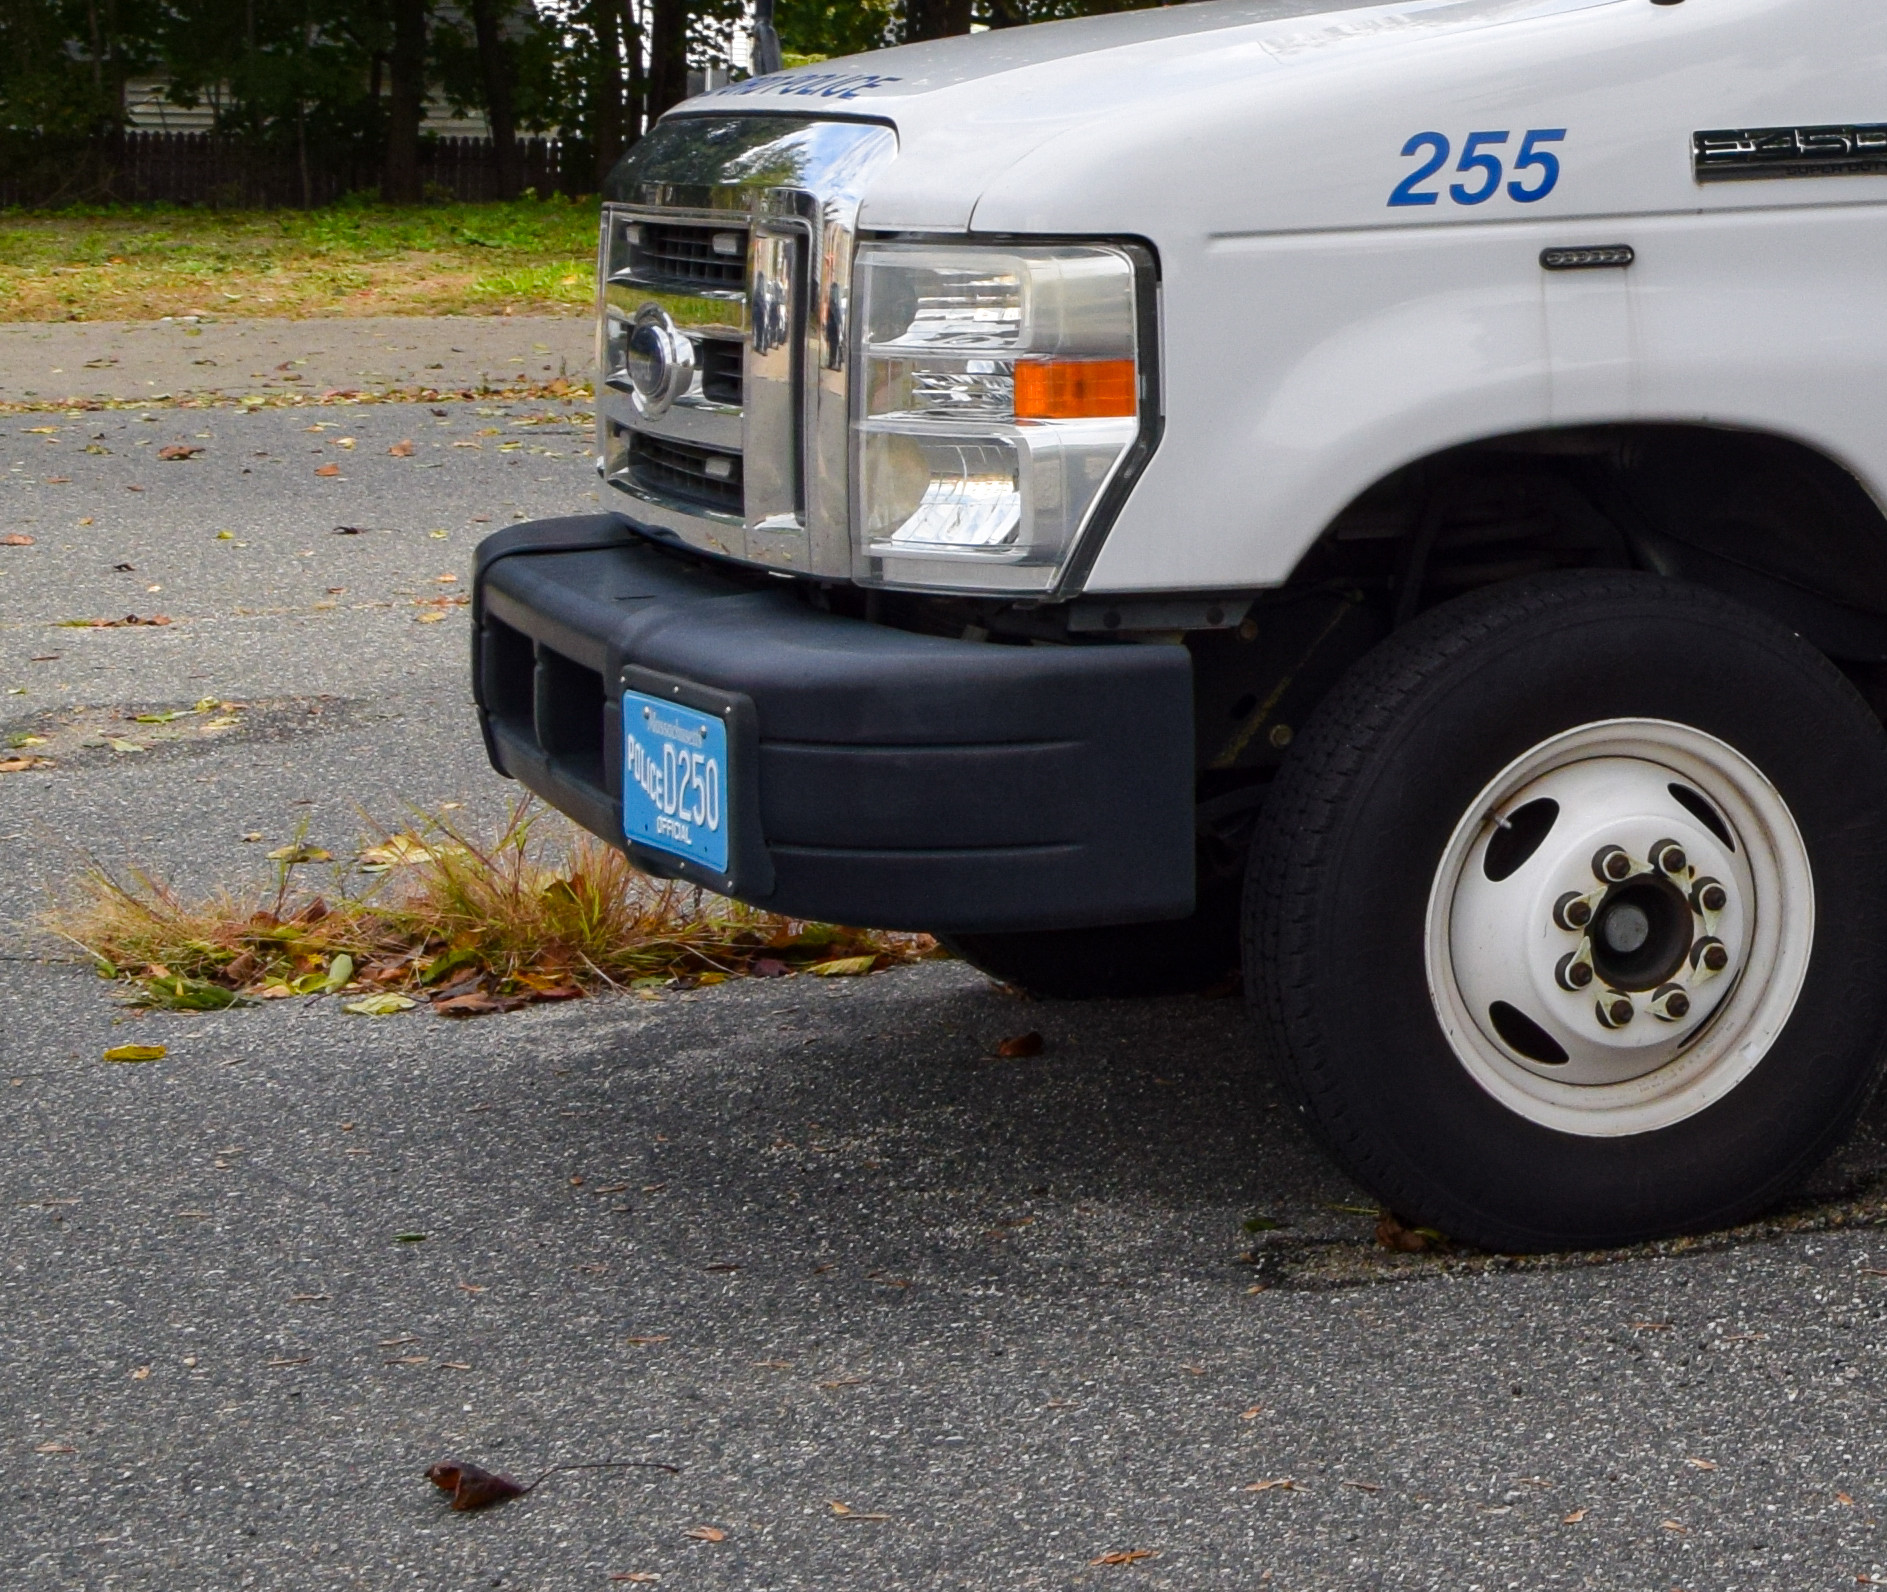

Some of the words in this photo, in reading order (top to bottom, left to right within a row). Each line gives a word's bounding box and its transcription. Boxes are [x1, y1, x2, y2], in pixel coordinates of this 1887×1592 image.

[1386, 128, 1567, 207] 255
[627, 733, 663, 810] POLICE
[663, 743, 720, 832] D250
[656, 815, 693, 845] OFFICIAL
